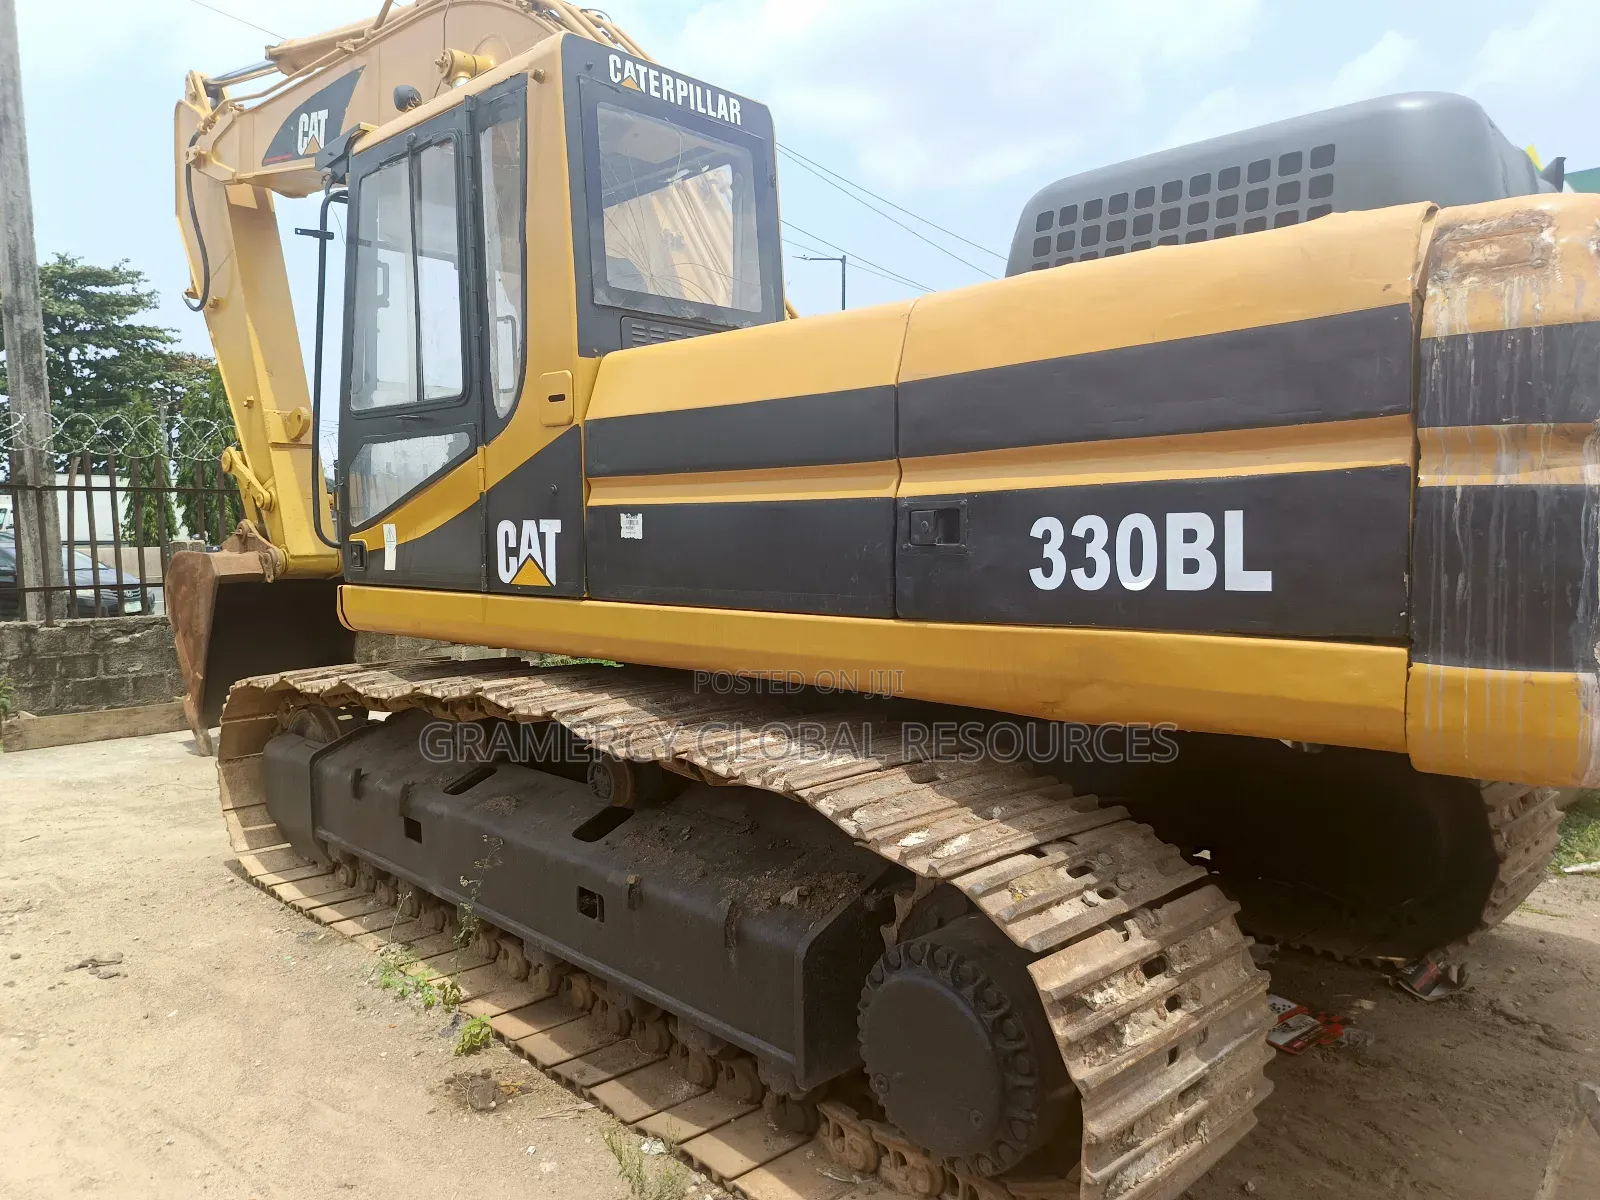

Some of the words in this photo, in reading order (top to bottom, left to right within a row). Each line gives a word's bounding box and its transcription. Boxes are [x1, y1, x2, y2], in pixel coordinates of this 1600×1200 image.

[608, 54, 741, 126] CATERPILLAR
[297, 109, 329, 156] CAT
[496, 519, 562, 587] CAT
[1028, 510, 1272, 591] 330BL
